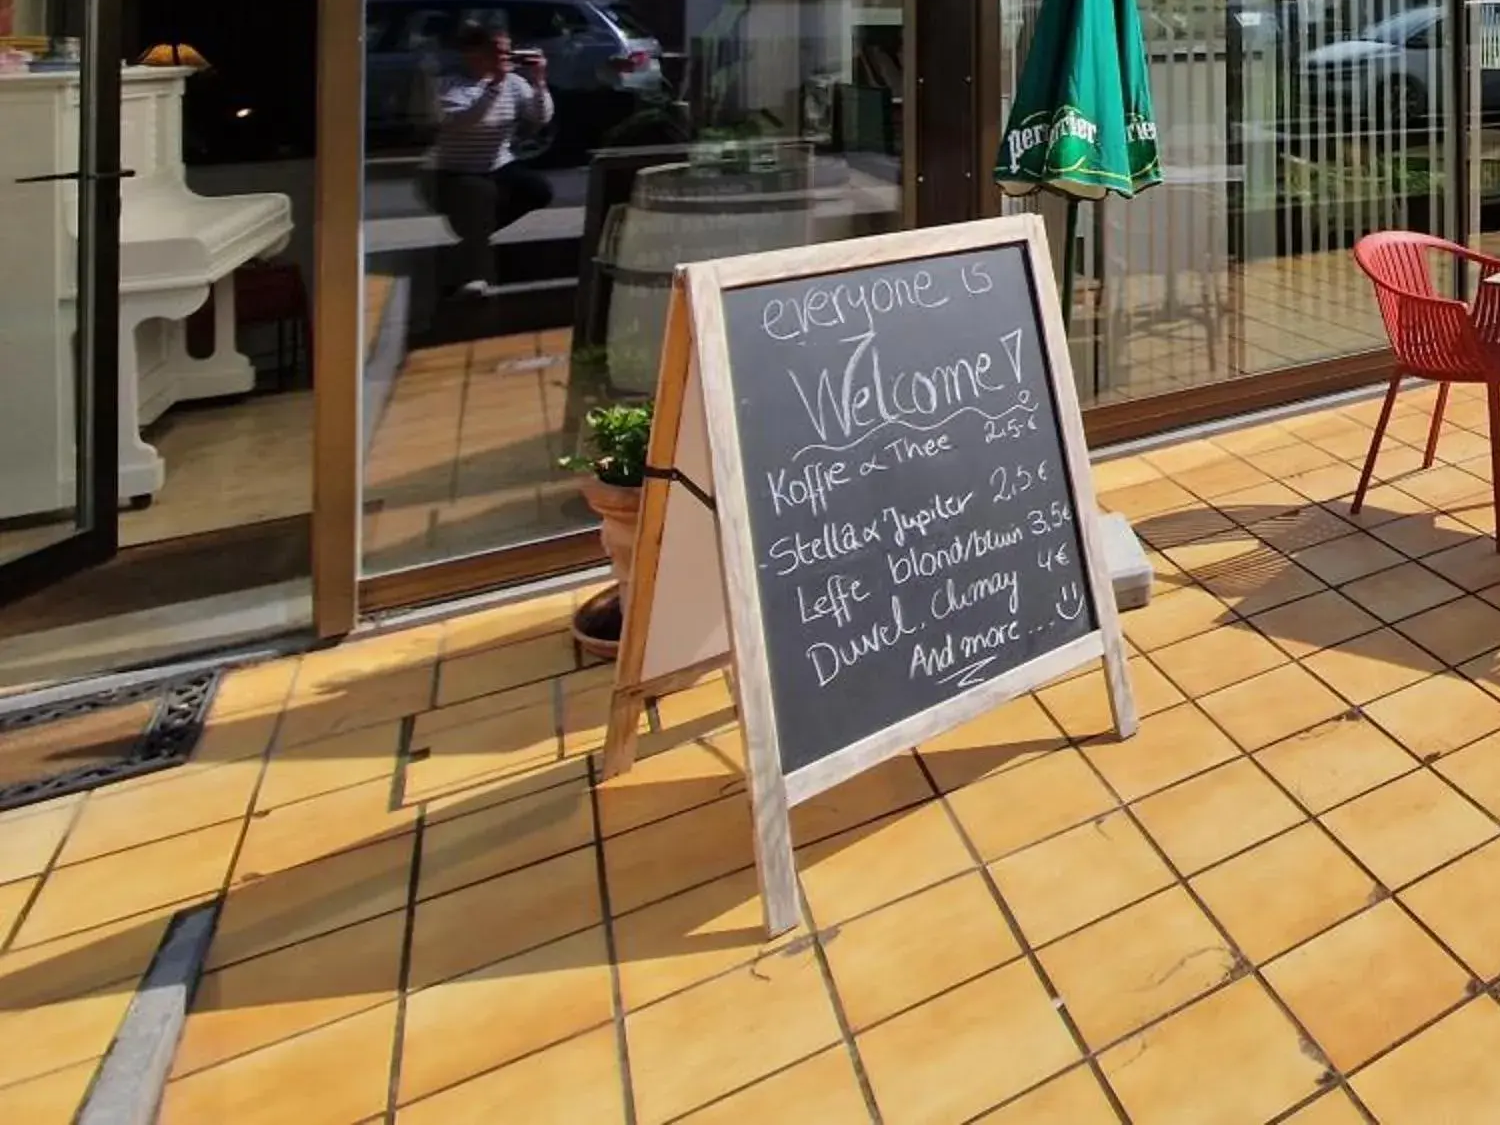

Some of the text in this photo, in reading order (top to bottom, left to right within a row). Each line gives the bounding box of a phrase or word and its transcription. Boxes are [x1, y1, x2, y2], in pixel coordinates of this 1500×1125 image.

[763, 263, 993, 340] everyone is
[767, 462, 851, 516] Koffie
[884, 434, 952, 463] Thee
[769, 522, 863, 575] Stella
[796, 575, 871, 628] Leffe
[909, 634, 955, 679] And
